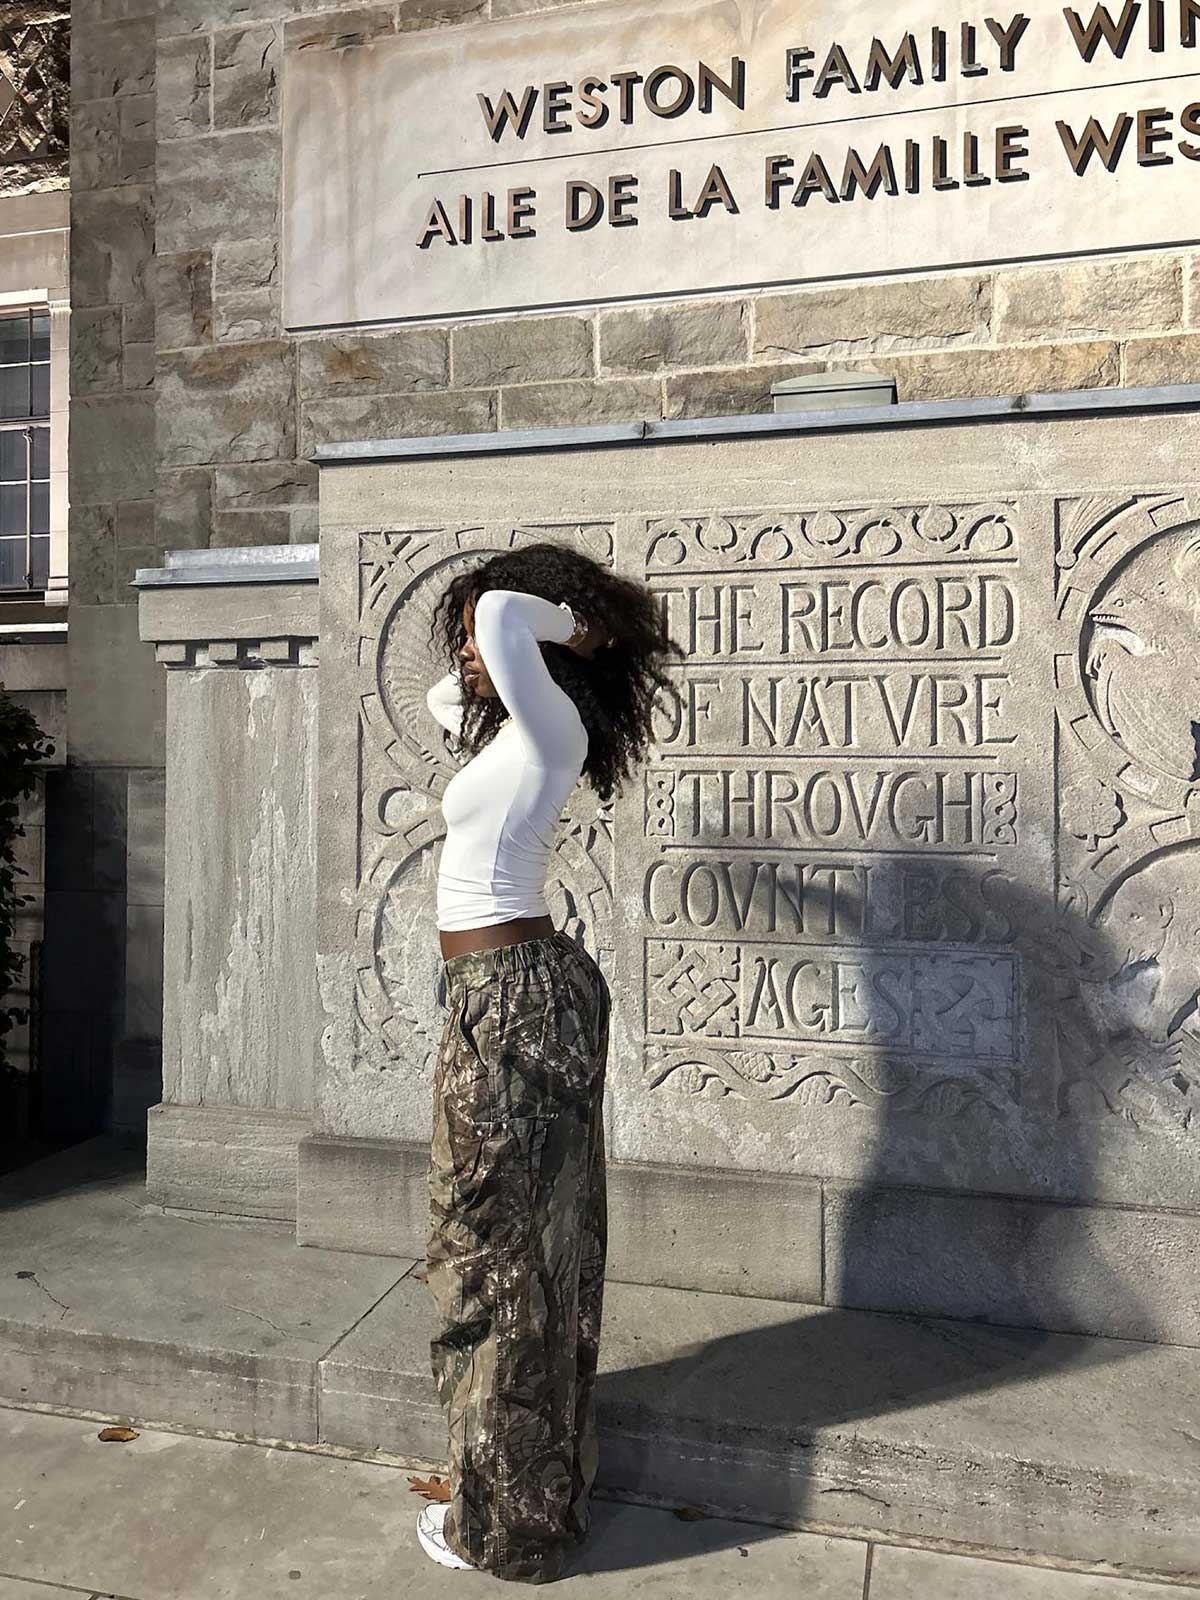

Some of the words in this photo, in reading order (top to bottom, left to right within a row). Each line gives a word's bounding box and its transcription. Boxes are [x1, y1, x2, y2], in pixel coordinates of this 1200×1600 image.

[476, 56, 746, 143] WESTON
[785, 13, 1031, 102] FAMILY
[415, 187, 537, 248] AILE
[565, 174, 639, 232] DE
[668, 163, 740, 220] LA
[764, 124, 1030, 210] FAMILLE
[1055, 102, 1200, 177] WES
[652, 583, 764, 656] THE
[779, 574, 1016, 655] RECORD
[650, 677, 723, 747] OF
[741, 673, 1019, 748] NATVRE
[678, 769, 985, 844] THROVGH
[643, 860, 1017, 944] COVNTLESS
[745, 957, 903, 1037] AGES
